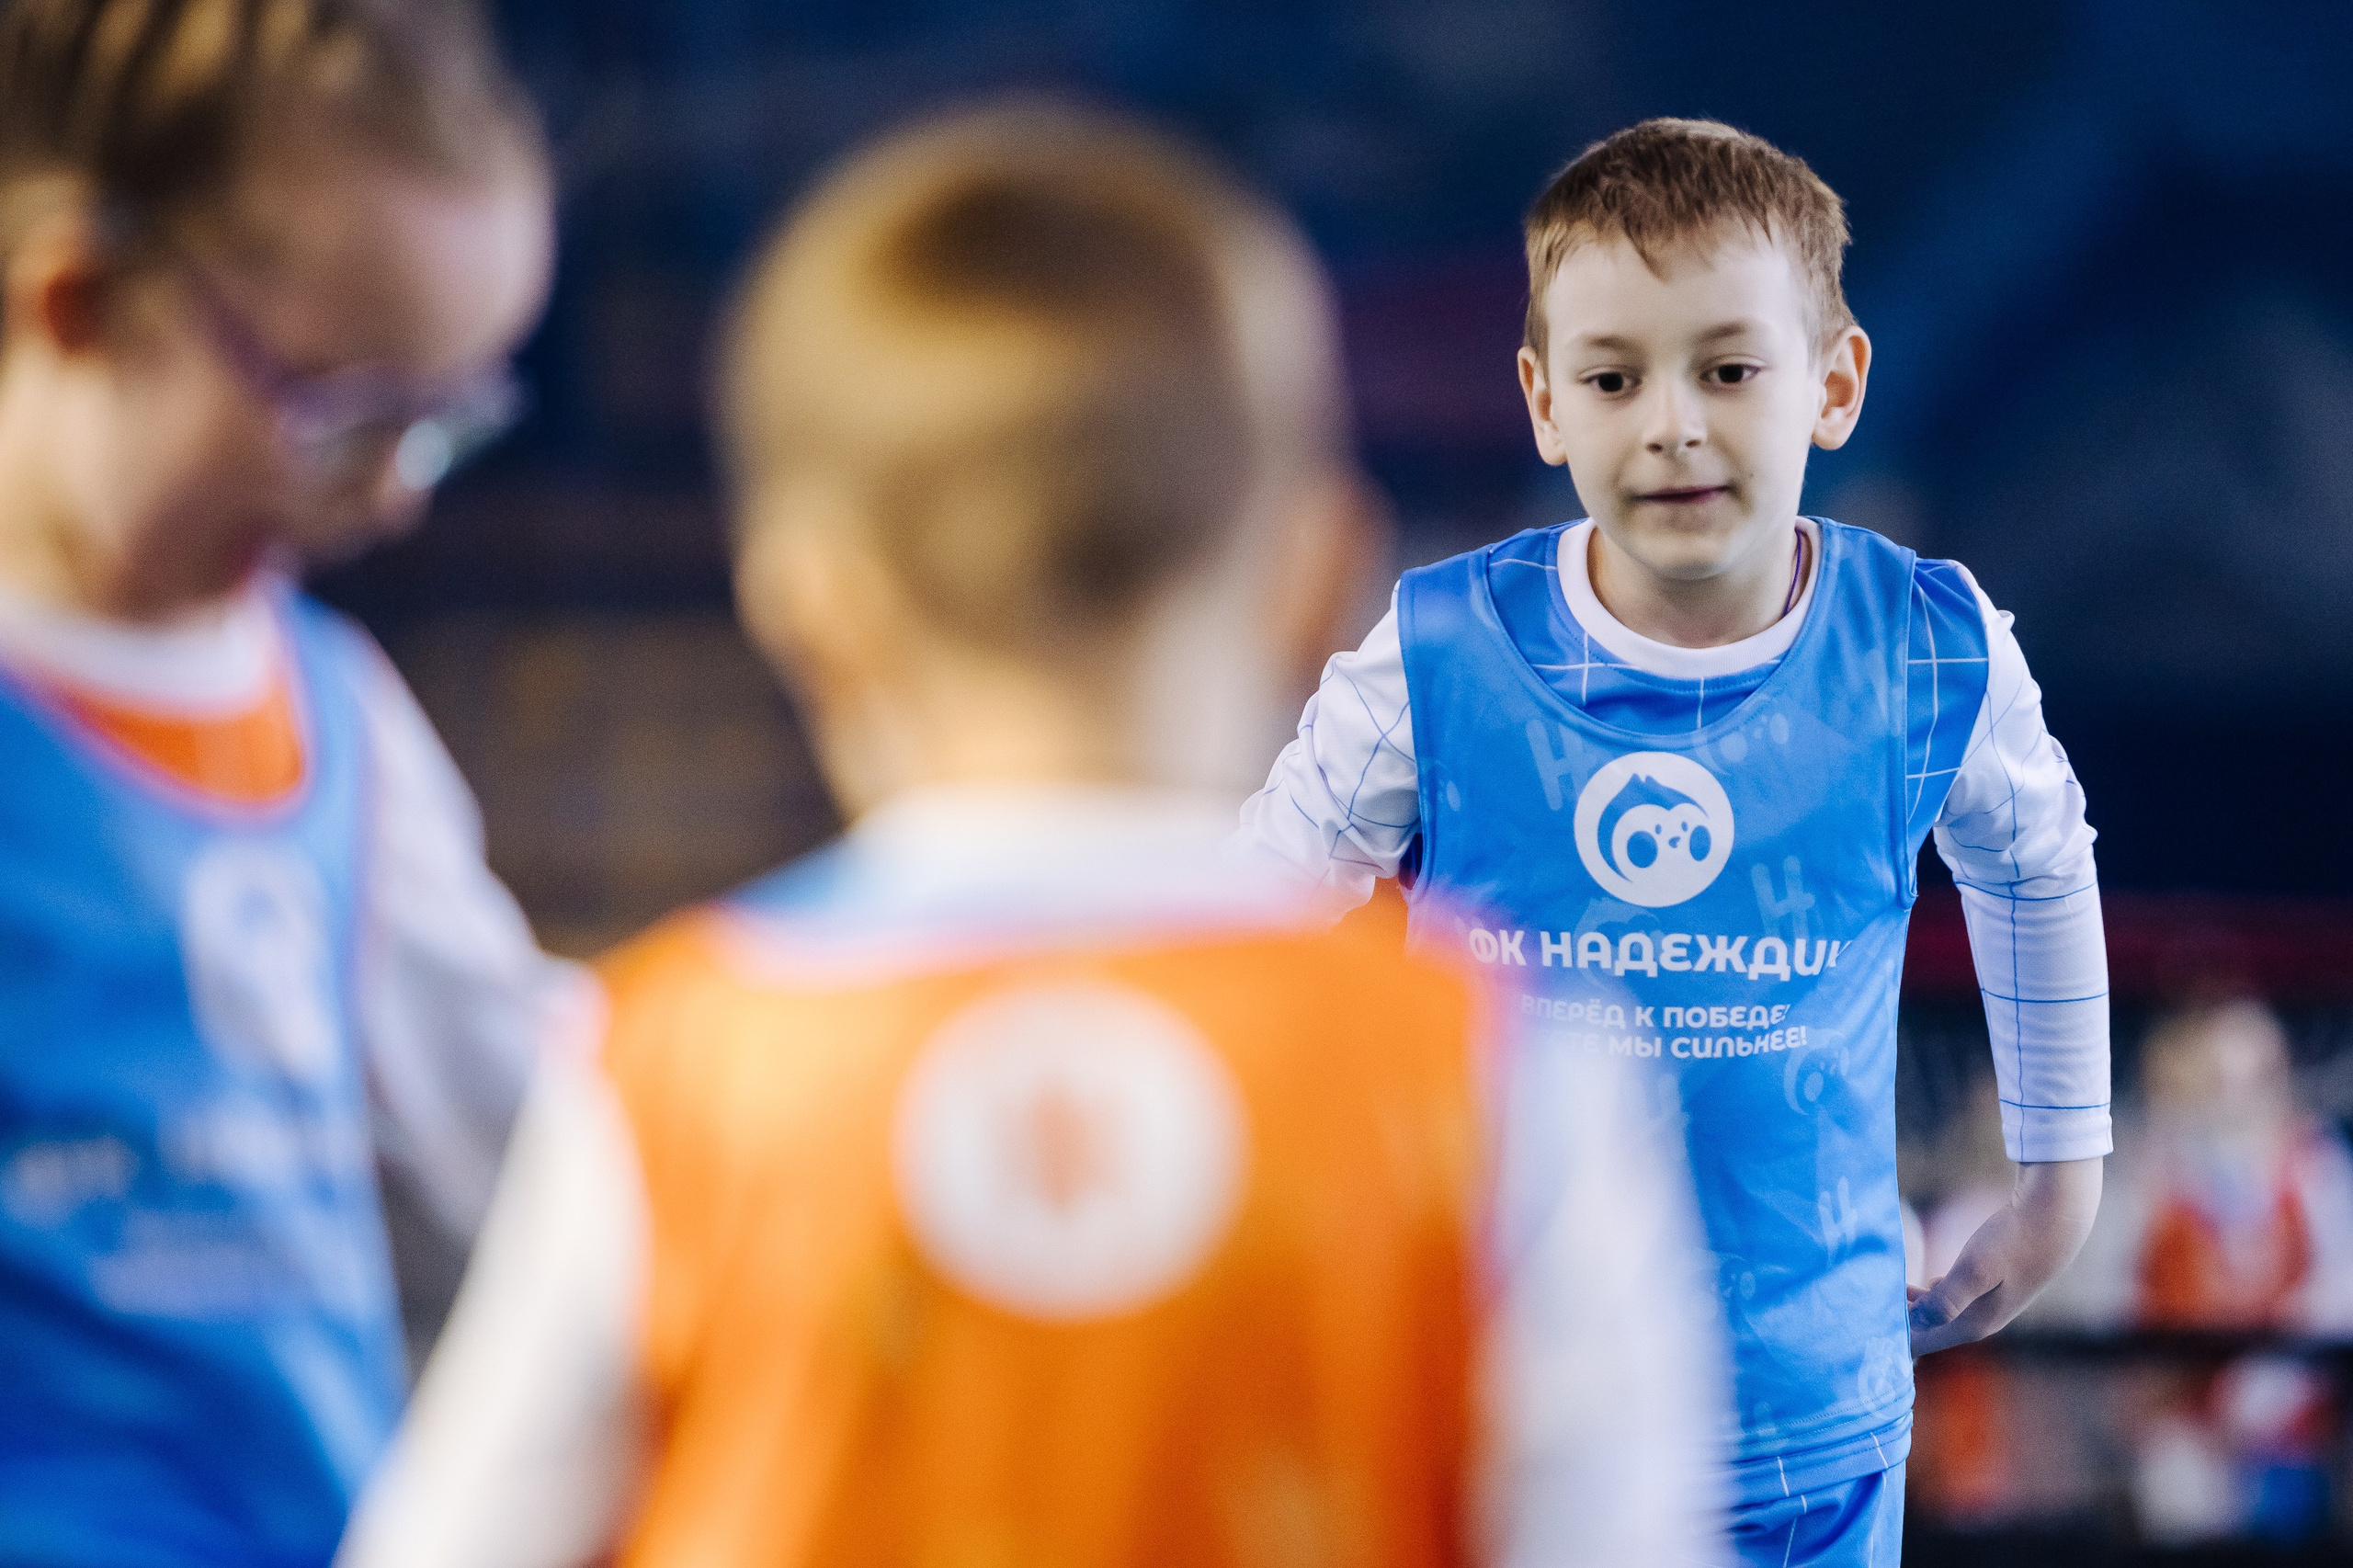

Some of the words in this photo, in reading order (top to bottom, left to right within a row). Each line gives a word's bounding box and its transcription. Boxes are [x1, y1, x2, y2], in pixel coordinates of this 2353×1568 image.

[1635, 1006, 1654, 1028] К
[1608, 1035, 1662, 1058] МЫ
[1670, 1025, 1807, 1059] СИЛЬНЕЕ!
